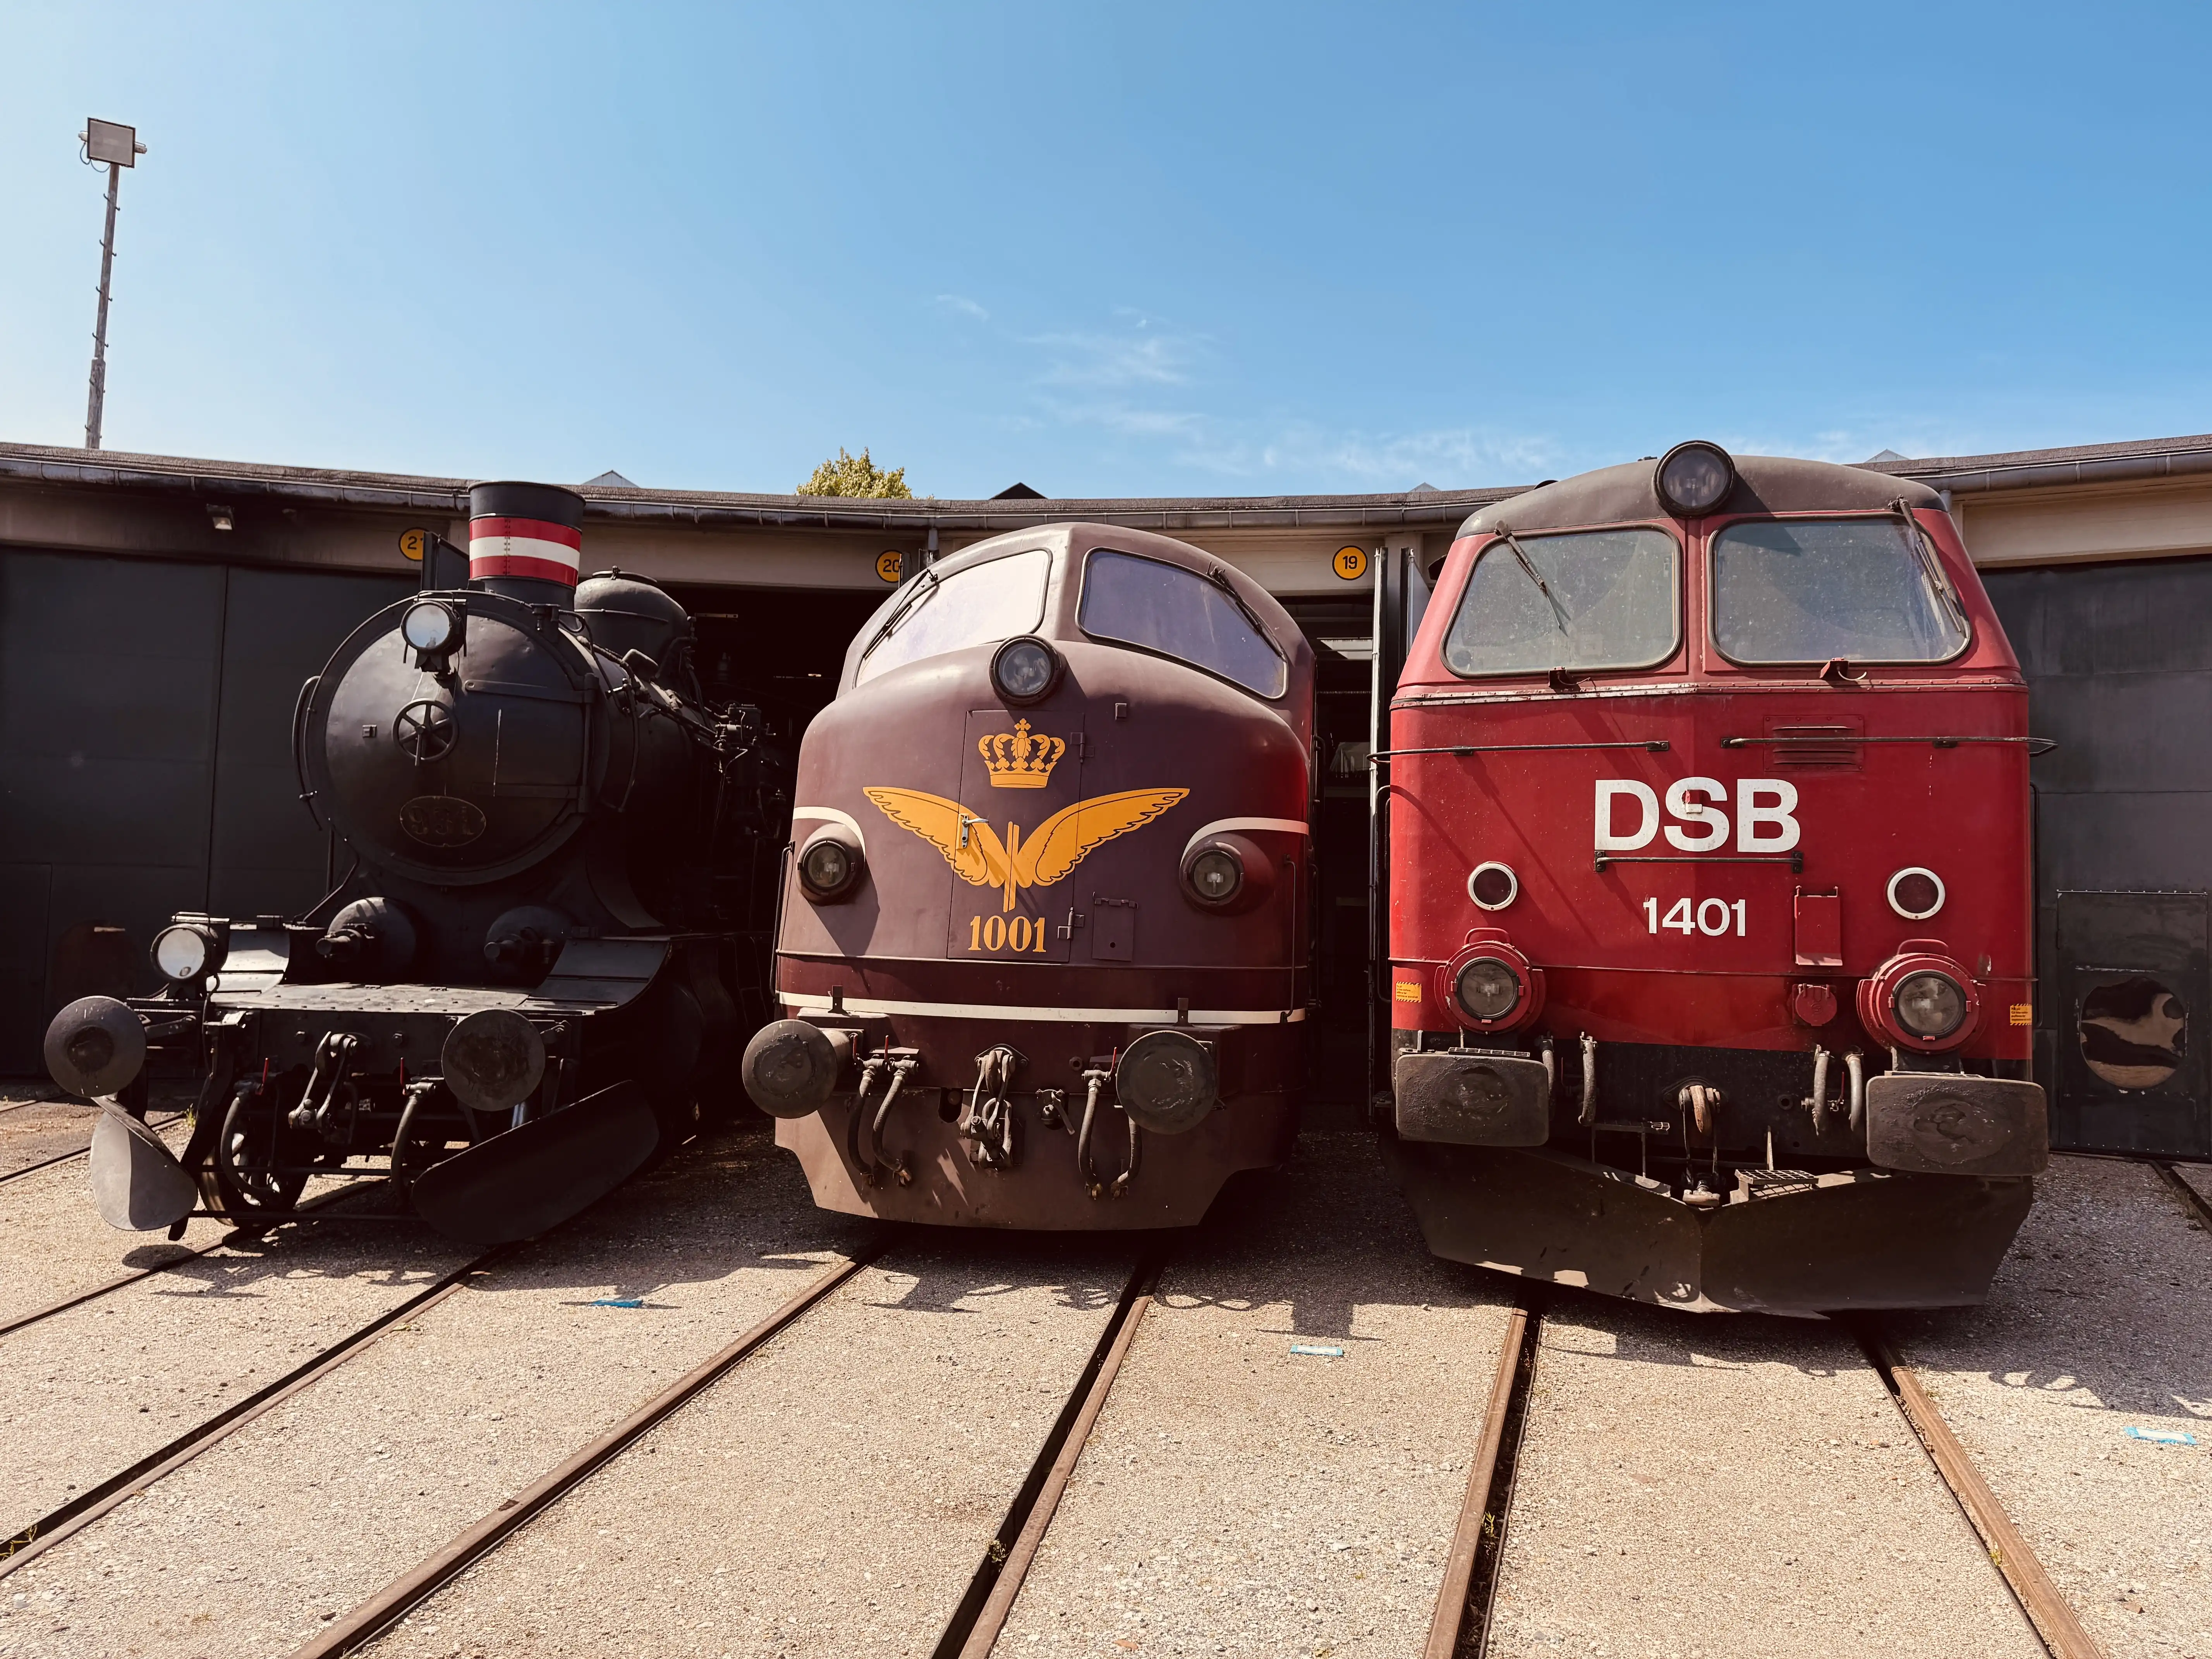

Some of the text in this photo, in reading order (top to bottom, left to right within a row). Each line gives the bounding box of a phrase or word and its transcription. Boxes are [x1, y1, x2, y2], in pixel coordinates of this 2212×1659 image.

[407, 536, 423, 550] 2
[883, 559, 899, 573] 20
[1343, 555, 1358, 569] 19
[1594, 776, 1800, 852] DSB
[1643, 897, 1746, 936] 1401
[968, 915, 1046, 953] 1001
